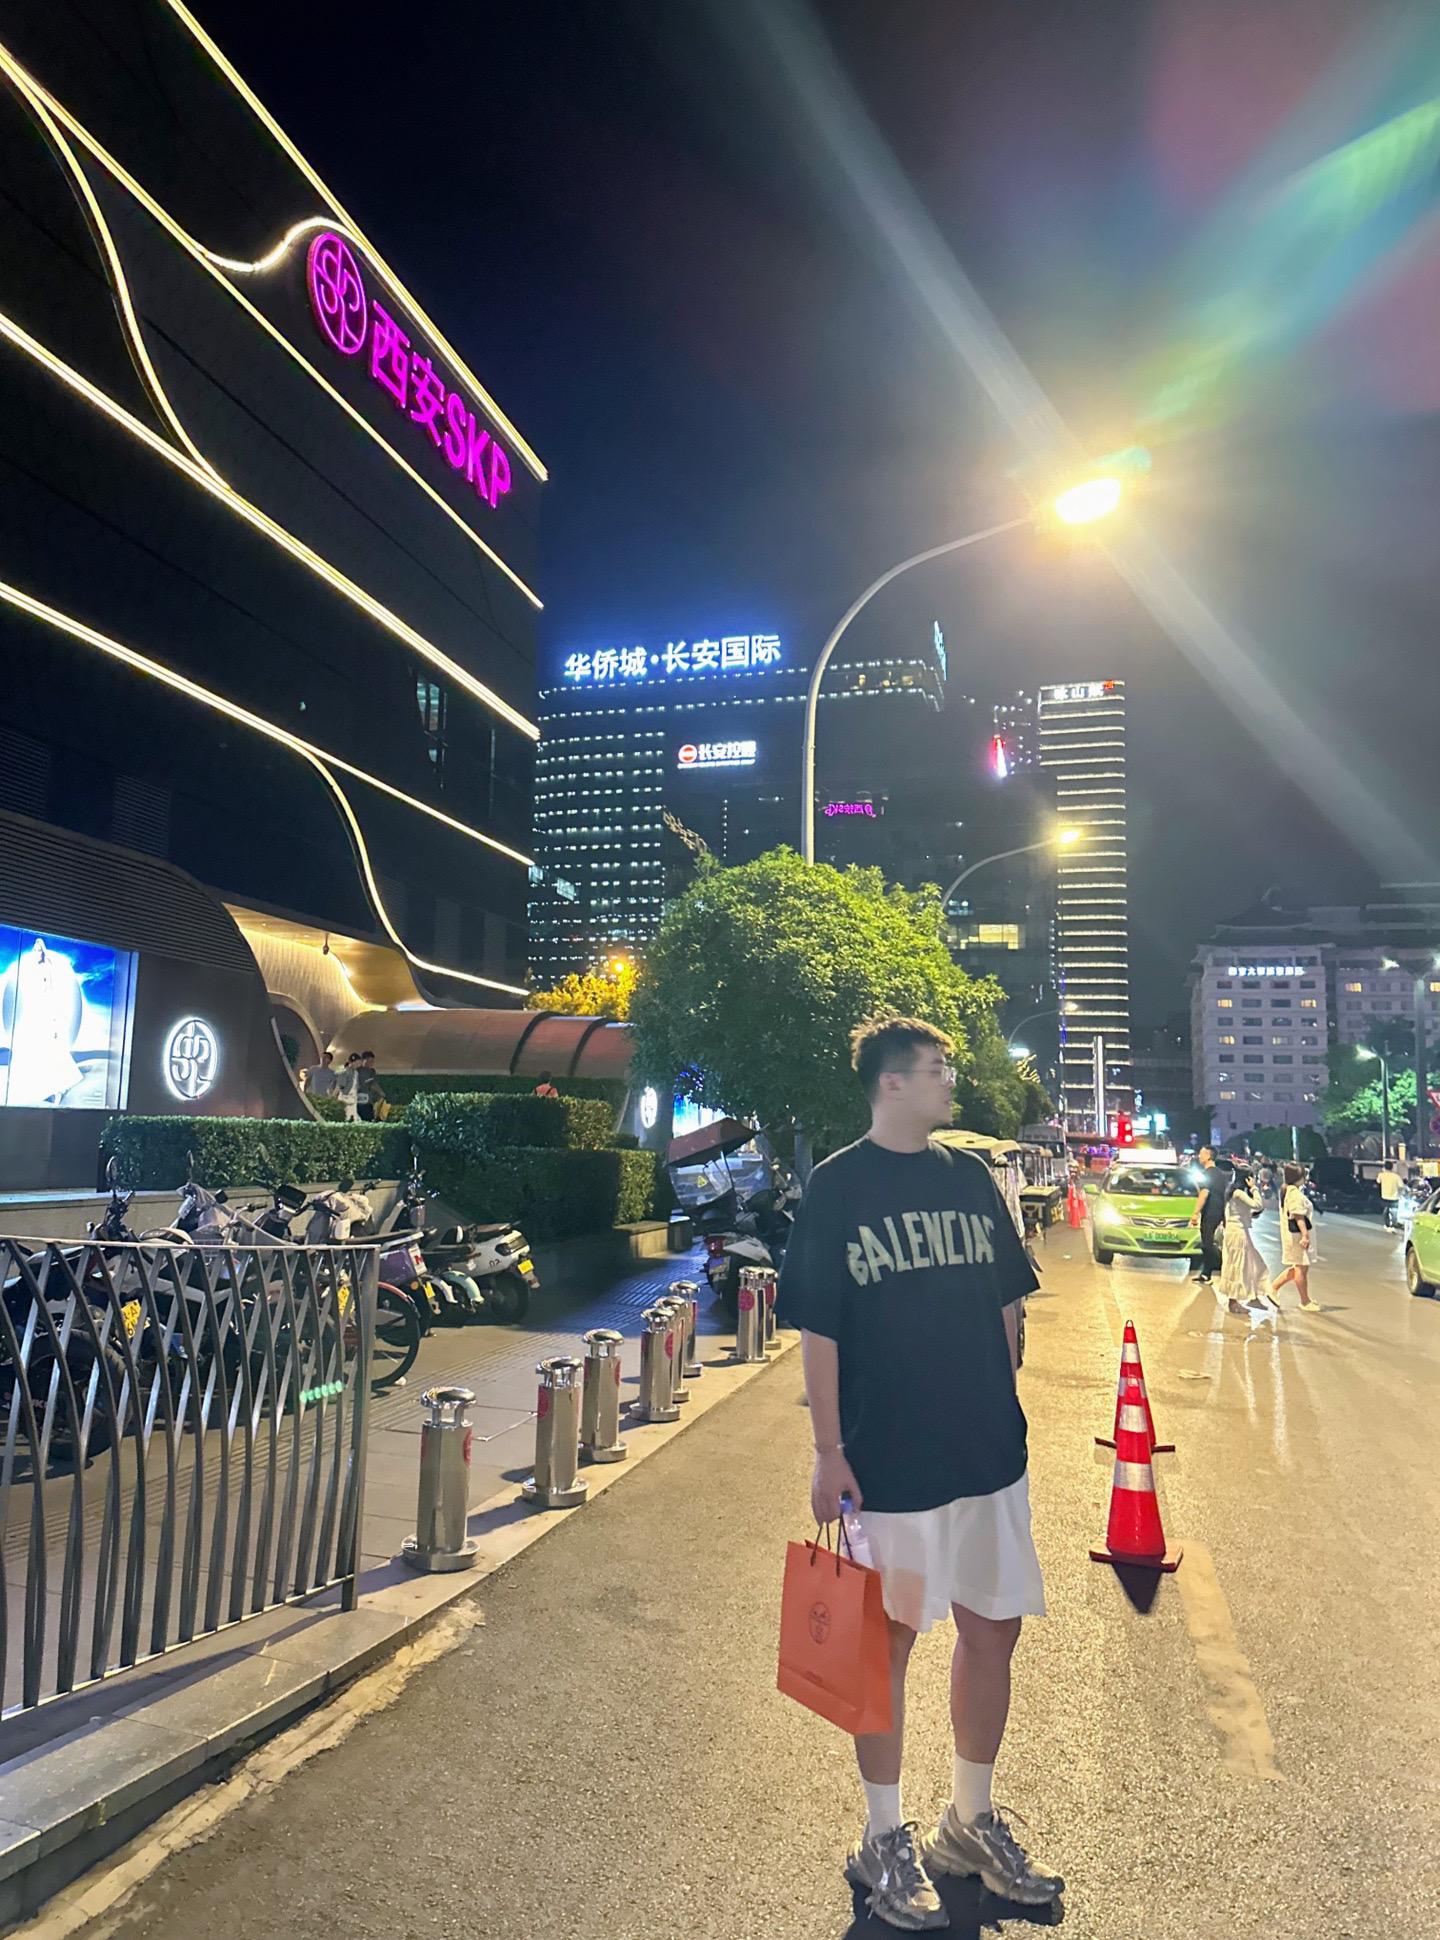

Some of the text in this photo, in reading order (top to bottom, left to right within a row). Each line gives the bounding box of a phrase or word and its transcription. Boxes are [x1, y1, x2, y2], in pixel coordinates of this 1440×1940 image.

[371, 301, 511, 508] 西安SKP
[564, 635, 781, 681] 华侨城·长安国际
